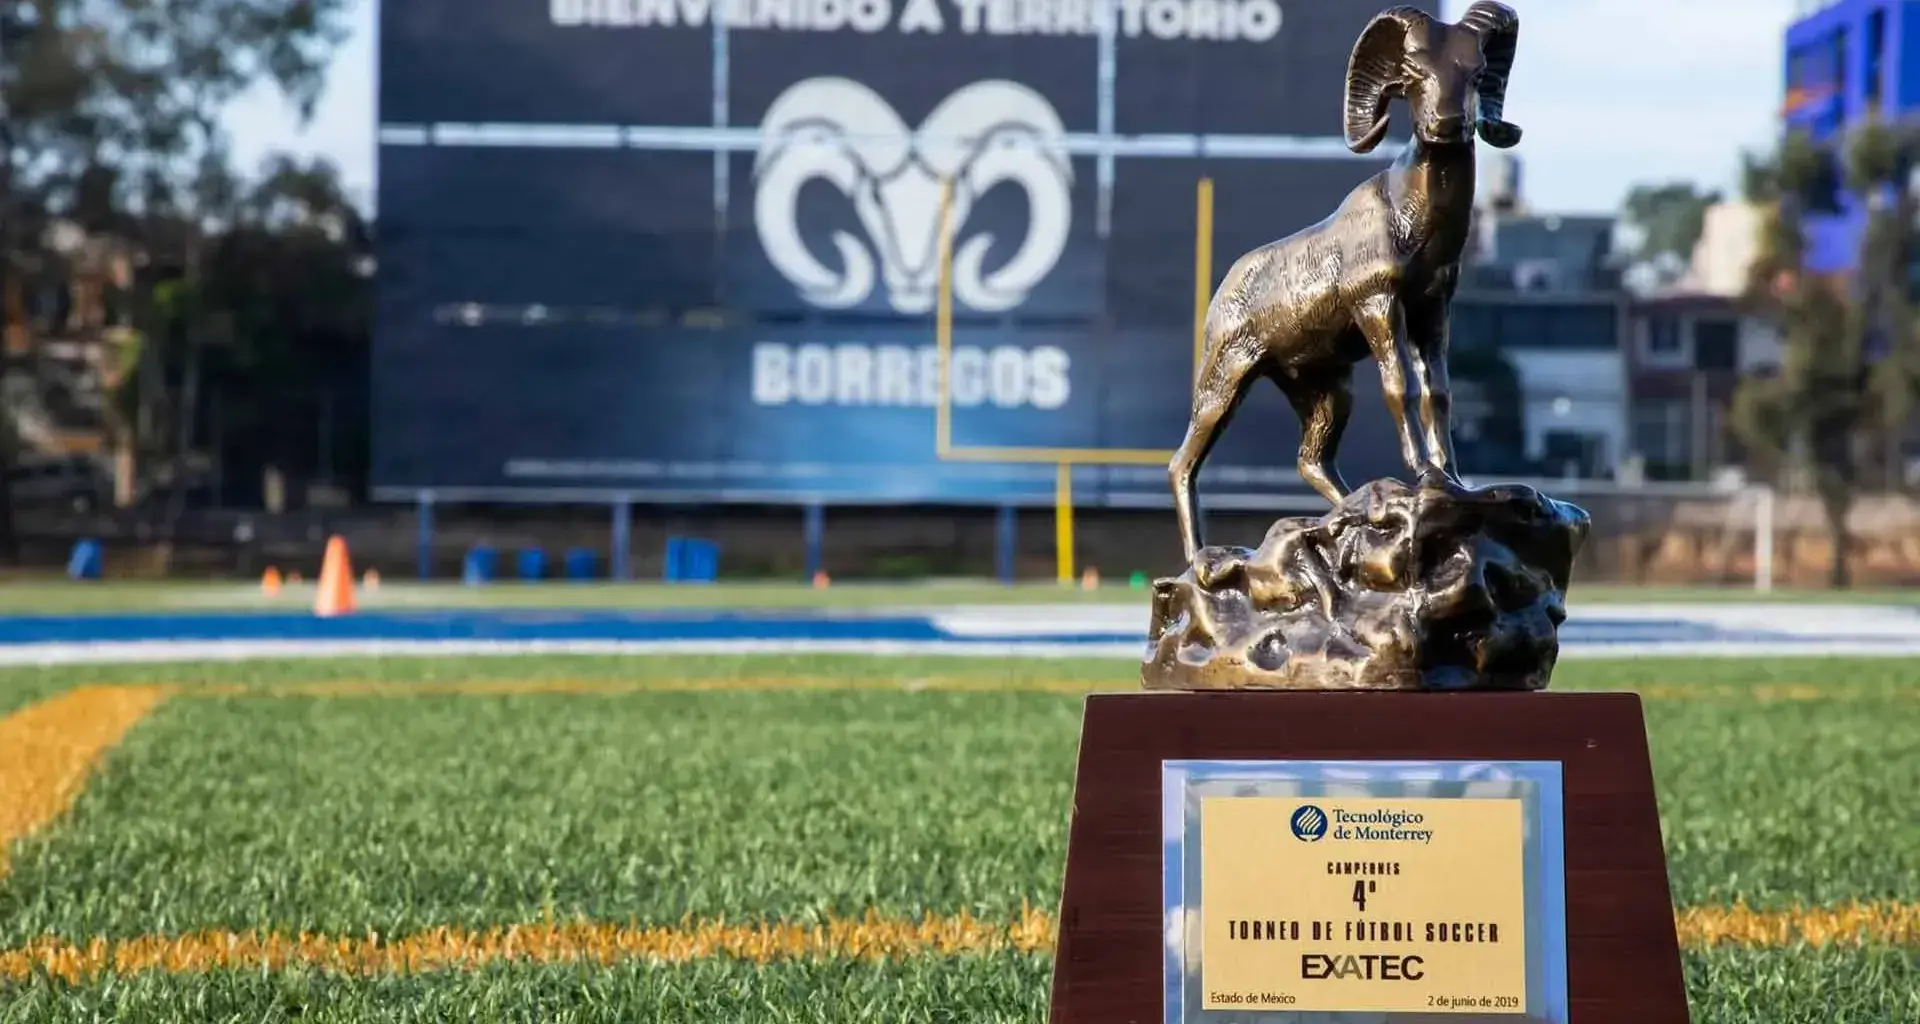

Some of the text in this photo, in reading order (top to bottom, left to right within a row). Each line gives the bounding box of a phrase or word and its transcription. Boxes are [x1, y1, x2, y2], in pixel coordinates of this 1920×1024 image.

[899, 0, 943, 34] A
[753, 343, 1071, 408] BORREGOS
[1333, 808, 1424, 828] Tecnológico
[1333, 825, 1433, 845] de Monterrey
[1327, 861, 1401, 876] CAMPEONES
[1229, 918, 1499, 943] TORNEO DE FÚTBOL SOCCER
[1302, 953, 1425, 981] EXATEC
[1210, 991, 1296, 1004] Estado de México
[1427, 995, 1519, 1009] 2 de junio de 2019
